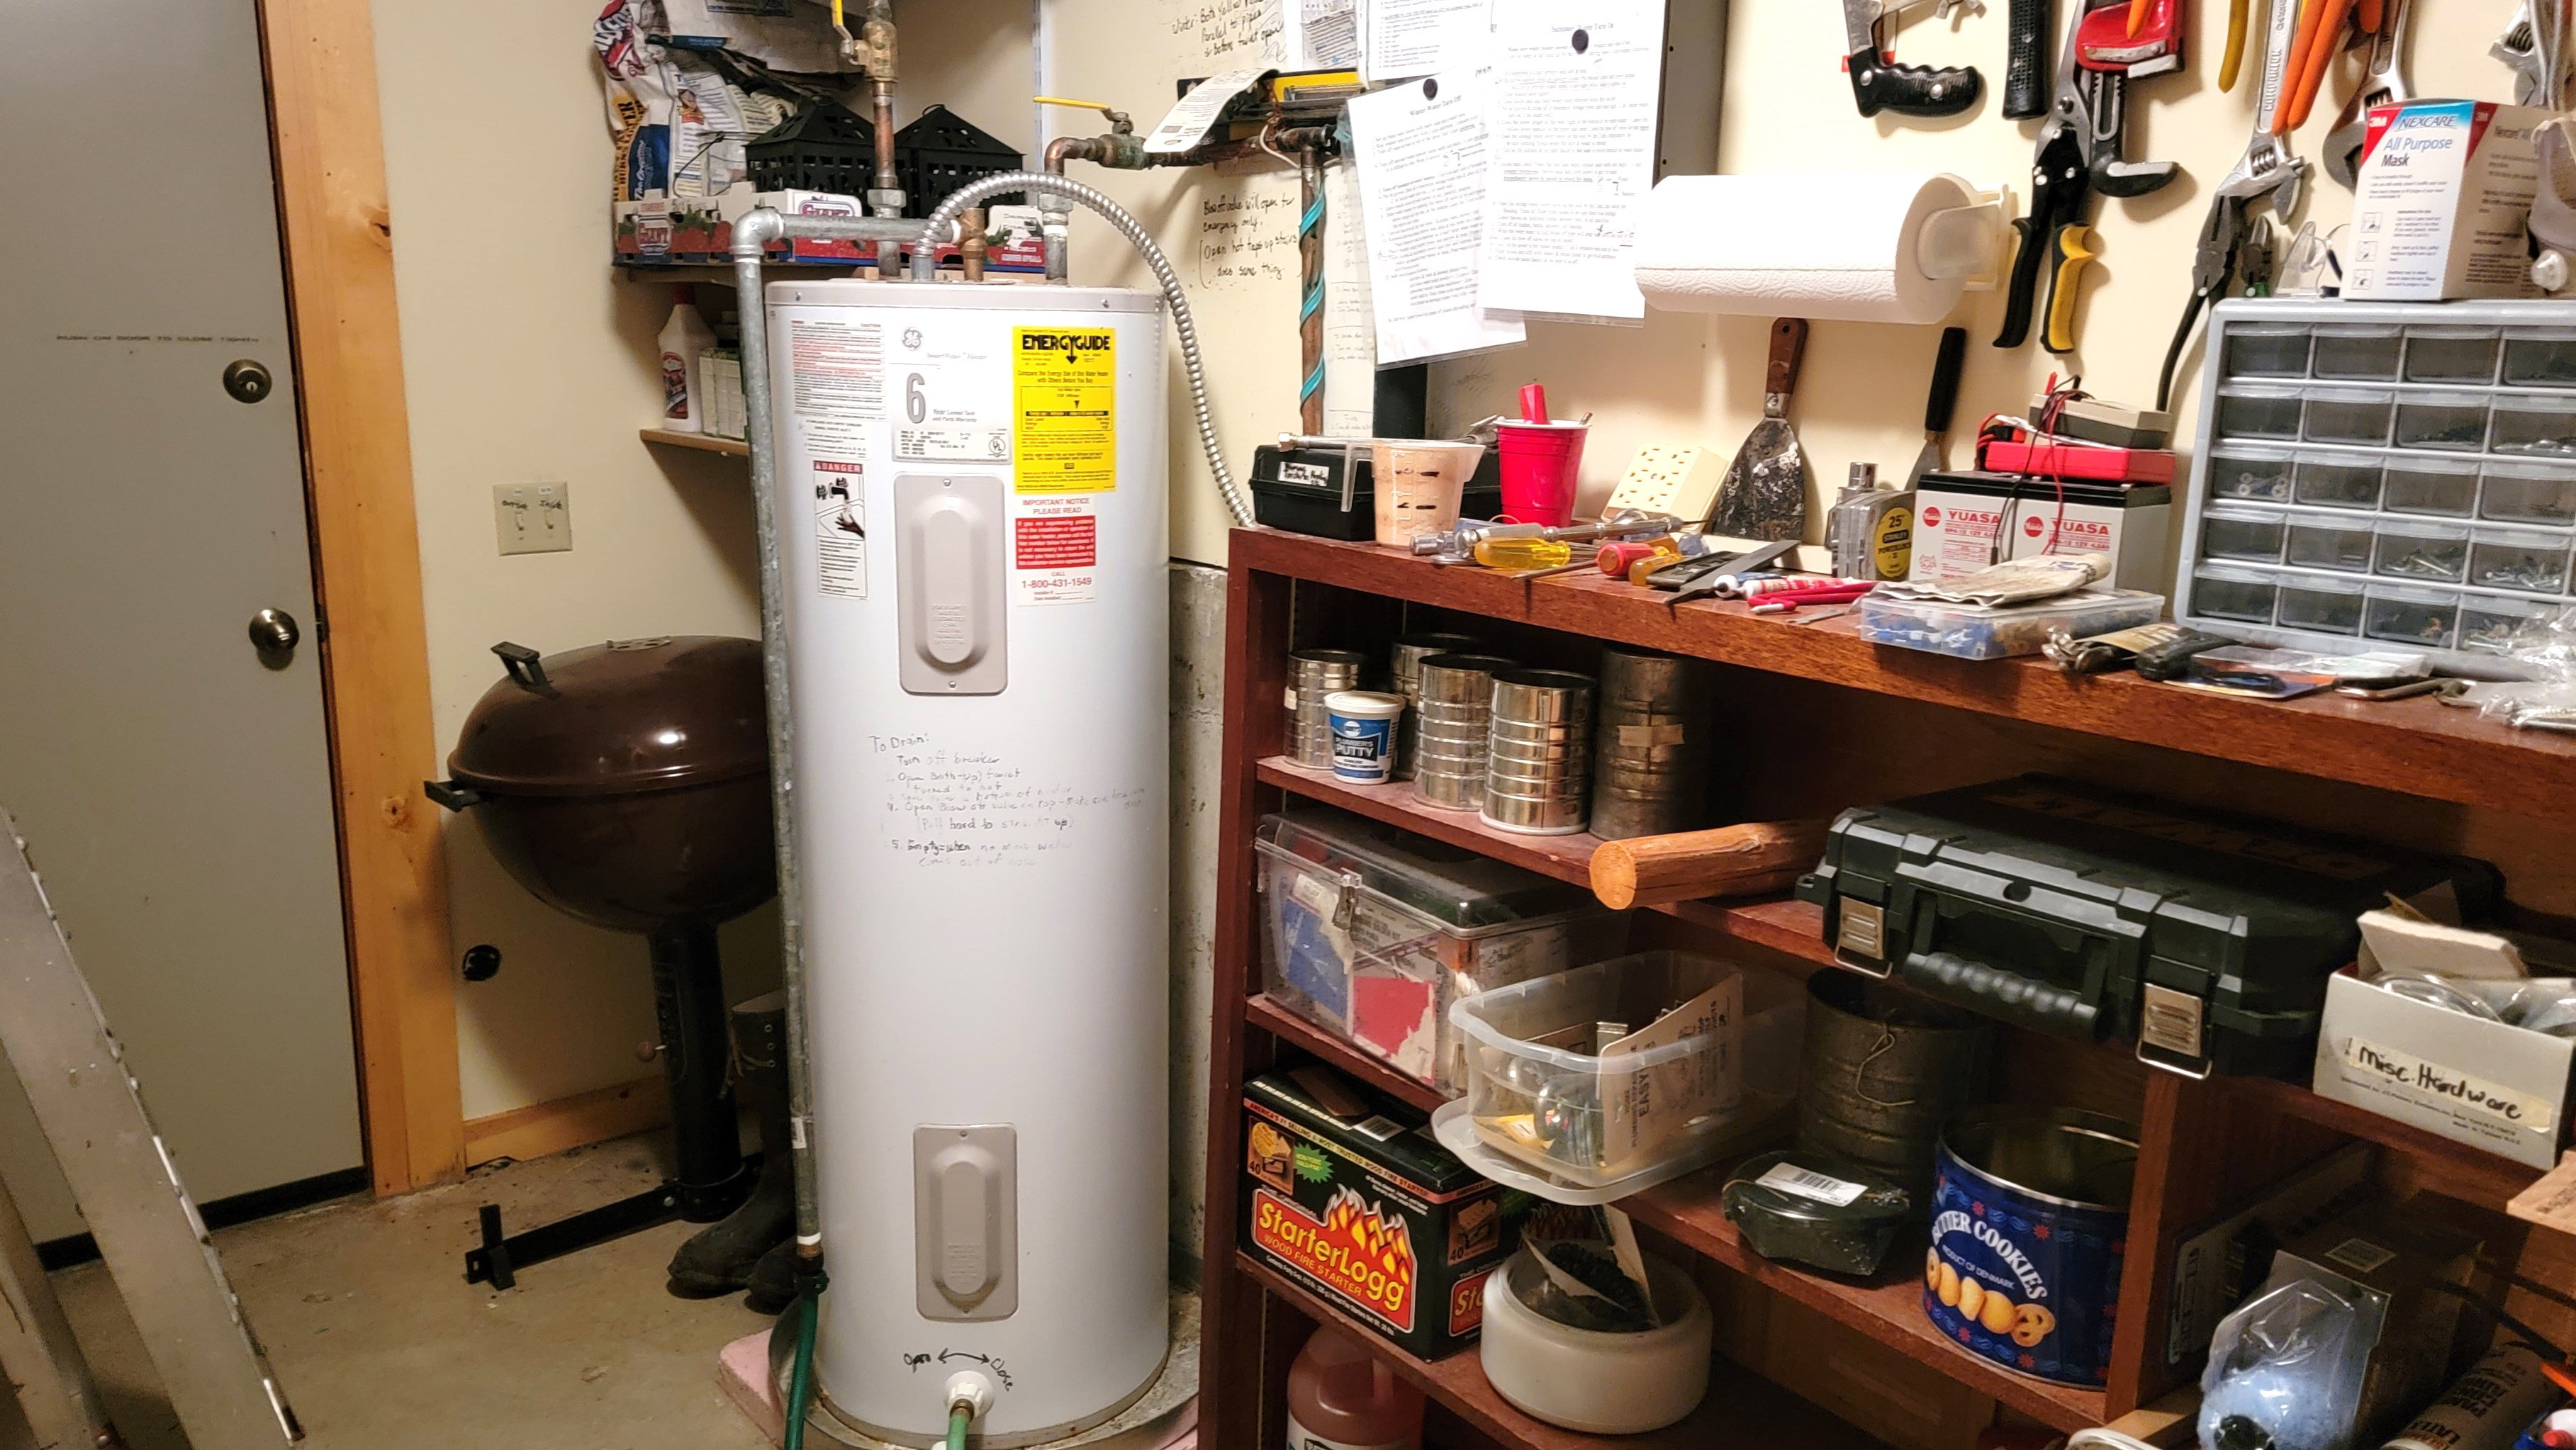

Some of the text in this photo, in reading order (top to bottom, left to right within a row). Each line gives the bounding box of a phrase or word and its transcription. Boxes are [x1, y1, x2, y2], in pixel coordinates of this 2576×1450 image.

[2369, 115, 2458, 130] 3M NEXCARE
[2383, 137, 2453, 153] All Purpose
[2380, 153, 2410, 167] Mask
[1021, 334, 1111, 351] ENERGYGUIDE
[906, 372, 926, 424] 6
[822, 463, 861, 472] DANGER
[1948, 510, 2002, 524] YUASA
[2052, 520, 2110, 535] YUASA
[1021, 577, 1092, 589] 1-800-431-1549
[868, 733, 929, 753] To Drain:
[1335, 743, 1374, 757] PUTTY
[896, 755, 920, 766] Turn
[905, 801, 933, 816] Open
[981, 817, 993, 829] to
[1638, 1073, 1651, 1117] EASY
[2417, 1062, 2522, 1120] Hardware
[1250, 1102, 1279, 1122] AMERICA'S
[1287, 1119, 1311, 1138] SELLING
[1318, 1137, 1336, 1152] MOST
[1336, 1145, 1364, 1164] TRUSTED
[1365, 1159, 1383, 1173] WOOD
[1383, 1168, 1399, 1182] FIRE
[1250, 1160, 1262, 1175] 40
[1259, 1203, 1405, 1311] StarterLogg
[1264, 1233, 1362, 1297] WOOD FIRE STARTER
[1973, 1220, 2048, 1300] COOKIES
[1964, 1259, 1976, 1272] OF
[1976, 1266, 2015, 1291] DENMARK
[903, 1353, 1014, 1392] Open Close
